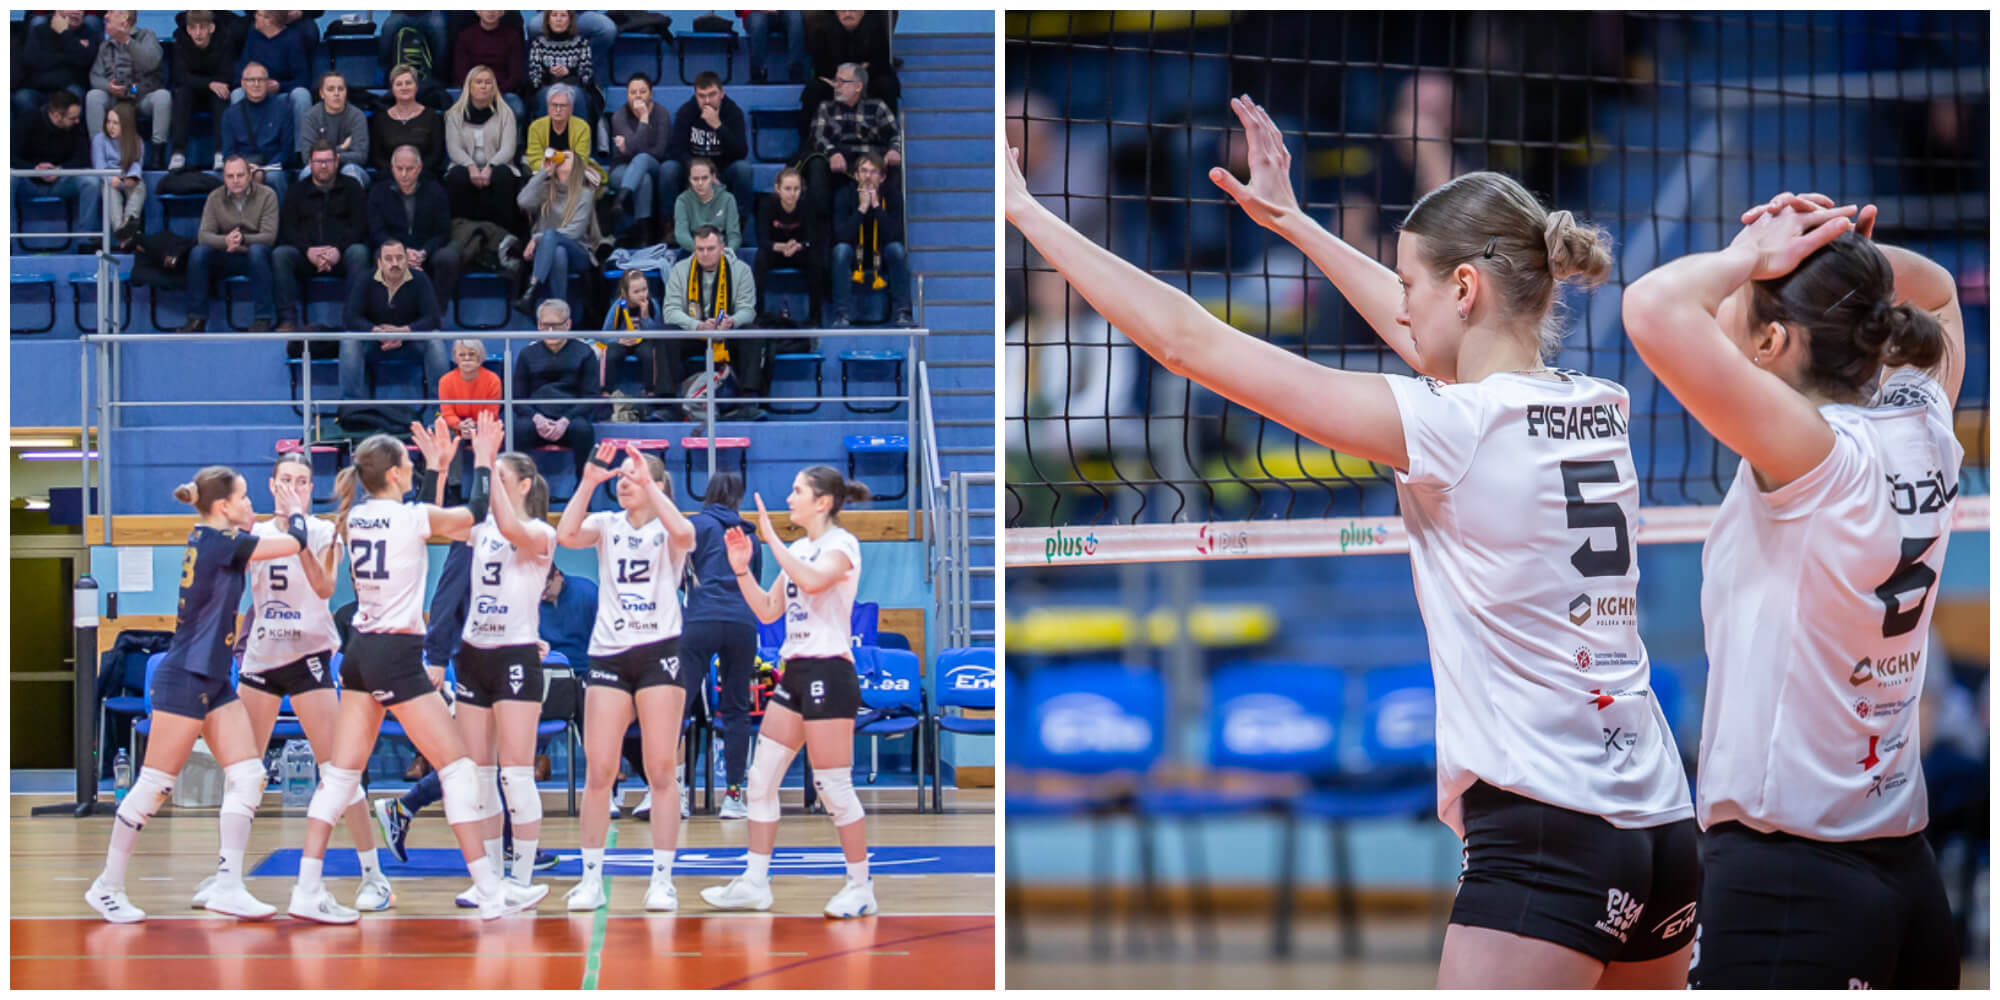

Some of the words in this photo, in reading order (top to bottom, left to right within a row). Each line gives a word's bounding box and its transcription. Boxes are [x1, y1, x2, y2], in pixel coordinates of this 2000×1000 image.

[1560, 460, 1631, 578] 5
[1046, 529, 1083, 564] plus
[1341, 523, 1373, 552] plus
[351, 539, 390, 580] 21
[617, 558, 650, 583] 12
[270, 565, 288, 590] 5
[482, 562, 502, 586] 3
[1875, 537, 1936, 638] 6
[264, 607, 301, 619] Enea
[509, 664, 523, 680] 3
